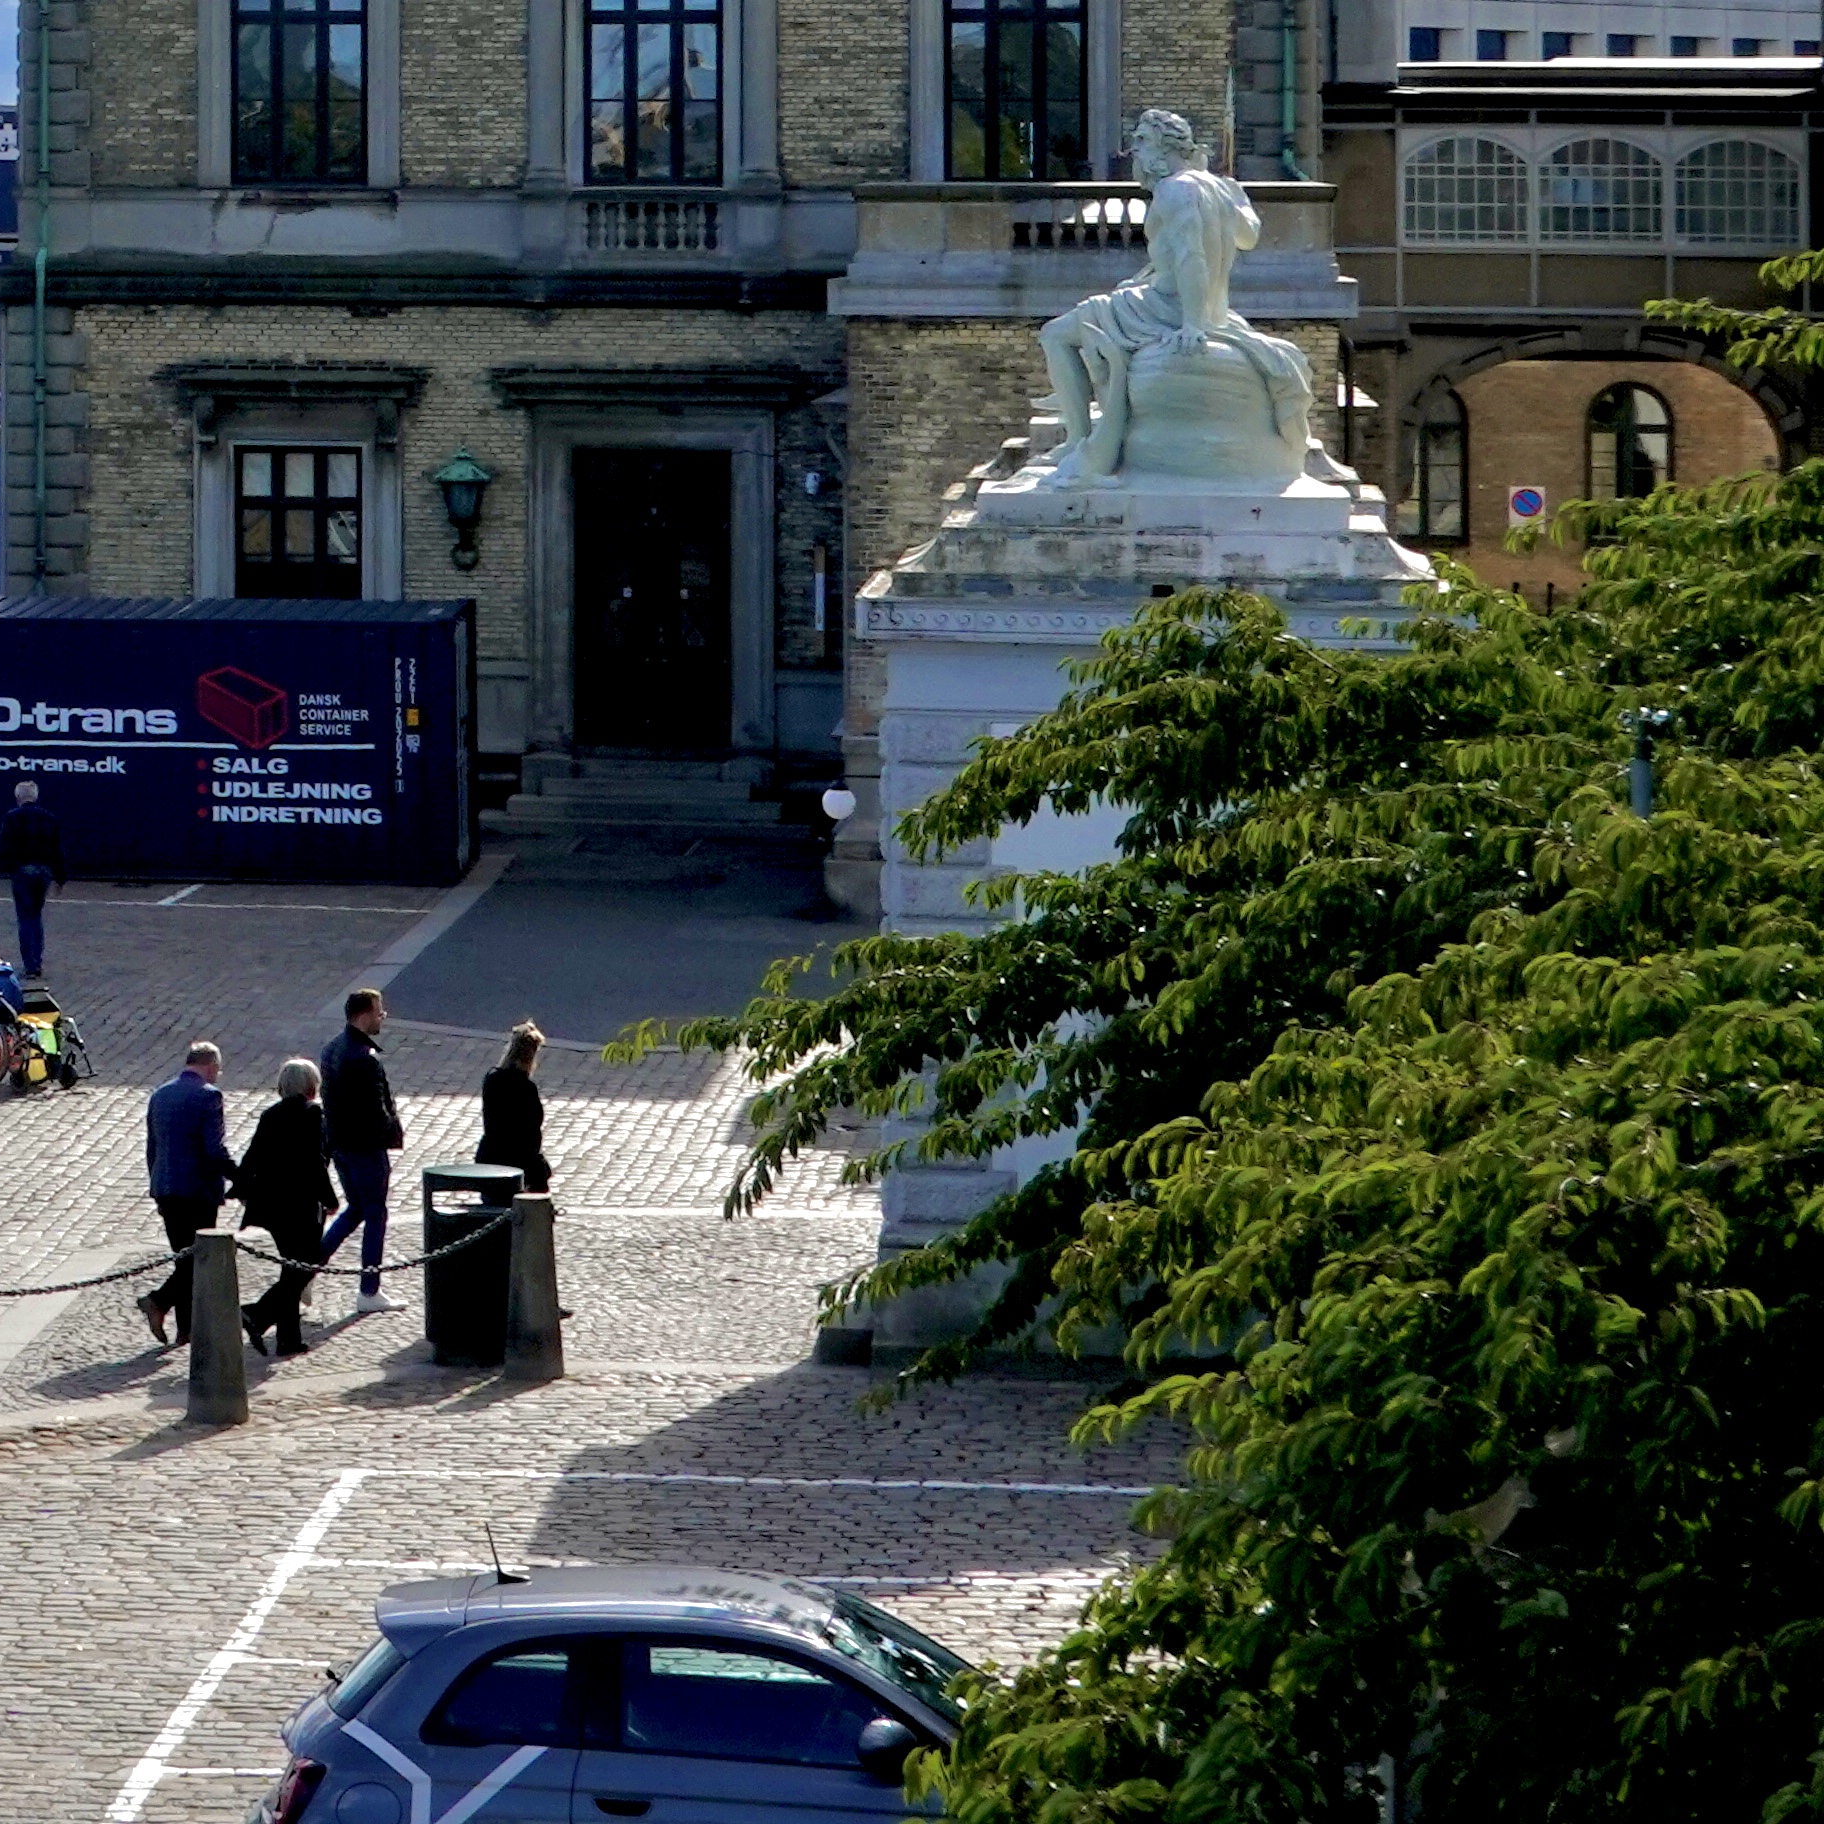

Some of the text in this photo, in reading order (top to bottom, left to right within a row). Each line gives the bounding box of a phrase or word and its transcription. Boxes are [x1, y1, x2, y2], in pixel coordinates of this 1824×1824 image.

[299, 694, 341, 706] DANSK
[299, 709, 369, 721] CONTAINER
[299, 724, 352, 736] SERVICE
[212, 757, 289, 774] SALG
[212, 781, 372, 800] UDLEJNING
[212, 805, 383, 825] INDRETNING
